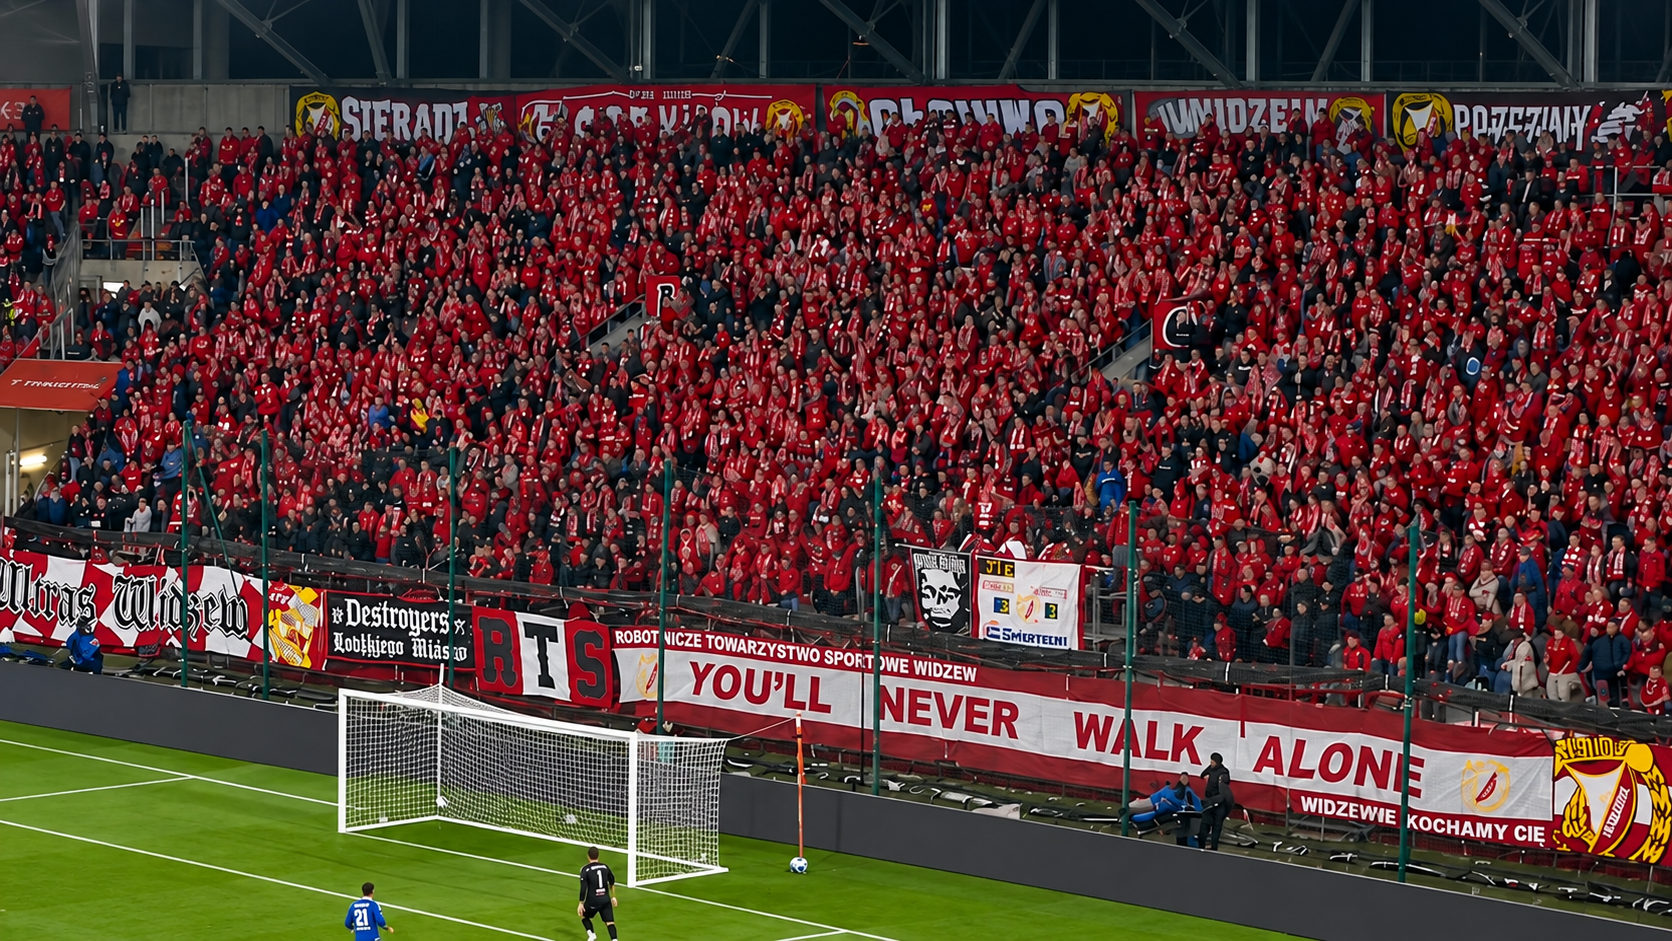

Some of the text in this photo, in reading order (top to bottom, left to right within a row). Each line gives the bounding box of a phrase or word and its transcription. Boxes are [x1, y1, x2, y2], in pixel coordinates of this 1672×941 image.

[344, 598, 450, 637] Destroyers
[615, 630, 702, 648] ROBOTNICZE
[706, 634, 820, 662] TOWARZYSTWO
[913, 660, 977, 682] WIDZEW
[689, 661, 1425, 799] YOU'LL NEVER WALK ALONE
[1406, 814, 1508, 841] KOCHAMY
[597, 870, 604, 888] 1
[354, 908, 369, 926] 21
